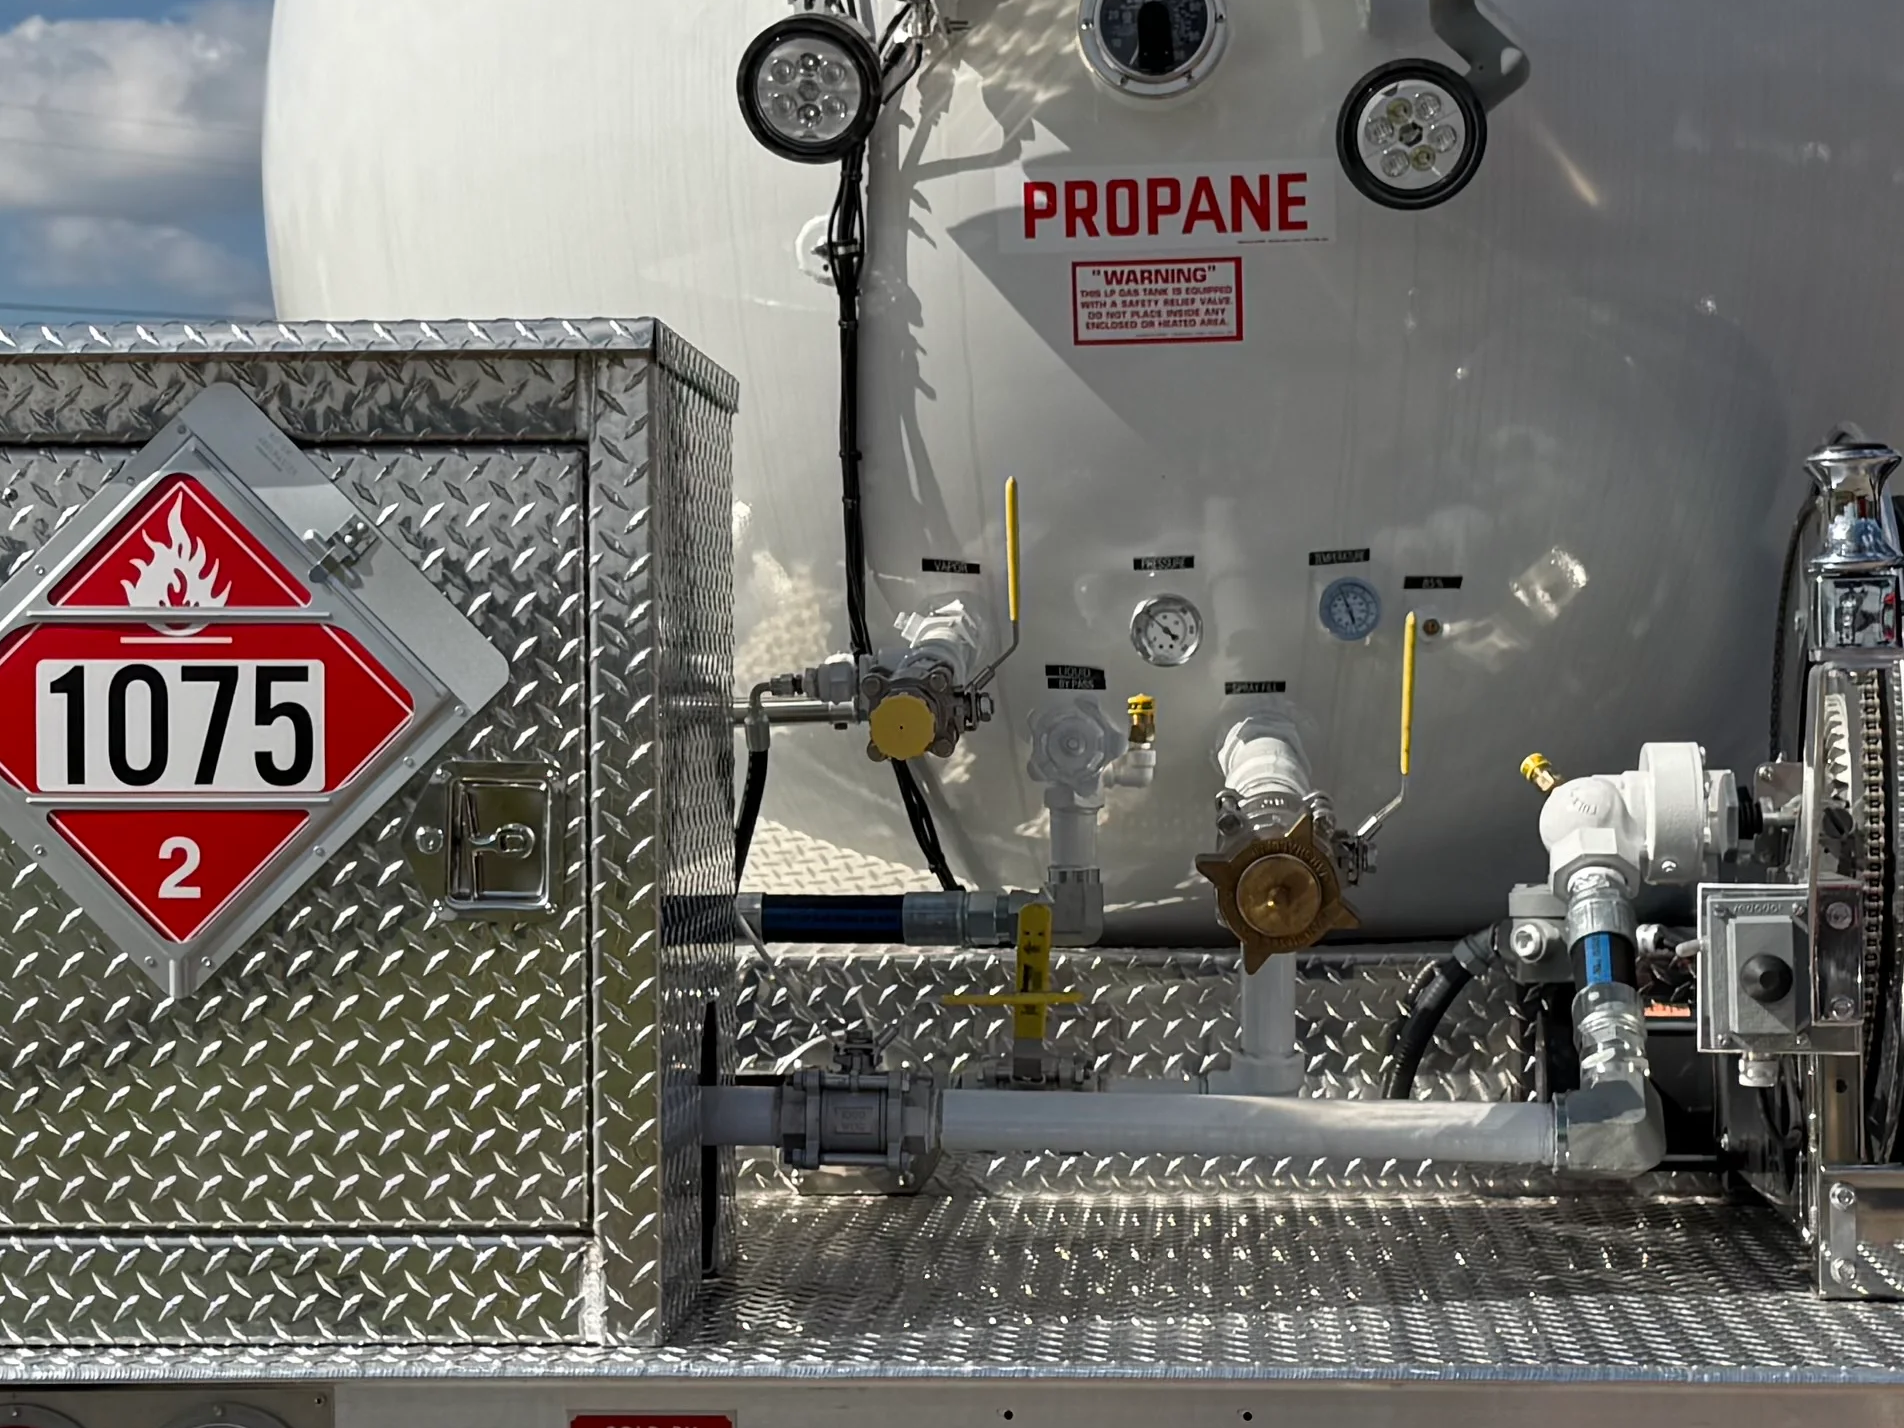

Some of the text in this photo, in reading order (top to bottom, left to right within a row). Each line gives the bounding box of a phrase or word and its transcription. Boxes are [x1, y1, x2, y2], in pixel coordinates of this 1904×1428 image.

[1024, 172, 1308, 239] PROPANE
[1080, 286, 1233, 298] THIS LP GAS TANK IS EQUIPPED
[1080, 296, 1233, 310] WITH A SAFETY RELIEF VALVE.
[1088, 307, 1226, 320] DO NOT PLACE INSIDE ANY
[1086, 318, 1228, 330] ENCLOSED OR HEATED AREA.
[934, 560, 968, 573] VAPOR
[1141, 557, 1185, 570] PRESSURE
[1058, 666, 1091, 676] LIQUID
[1072, 679, 1094, 689] PASS
[49, 663, 314, 786] 1075
[158, 836, 201, 899] 2
